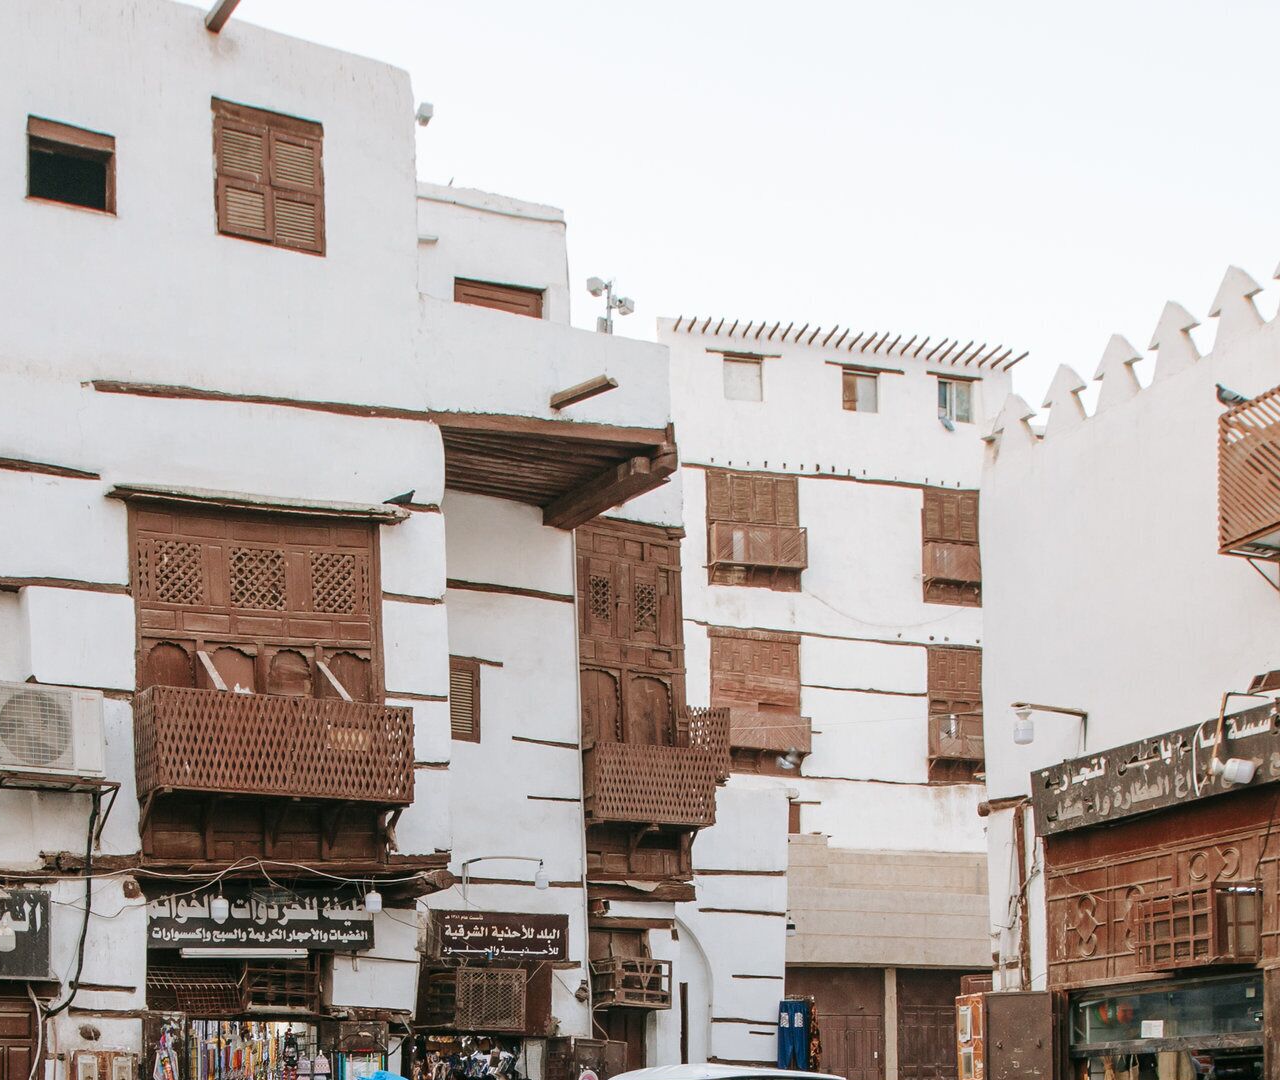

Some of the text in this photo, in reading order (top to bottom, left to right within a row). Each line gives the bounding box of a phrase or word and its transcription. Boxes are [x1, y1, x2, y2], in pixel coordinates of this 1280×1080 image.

[231, 896, 318, 925] للخردوات
[323, 896, 372, 926] طيفة
[213, 928, 247, 942] والسبح
[248, 928, 286, 942] الكريمة
[329, 929, 368, 943] الفضيات
[445, 925, 560, 943] البلد للأحذية الشرقية
